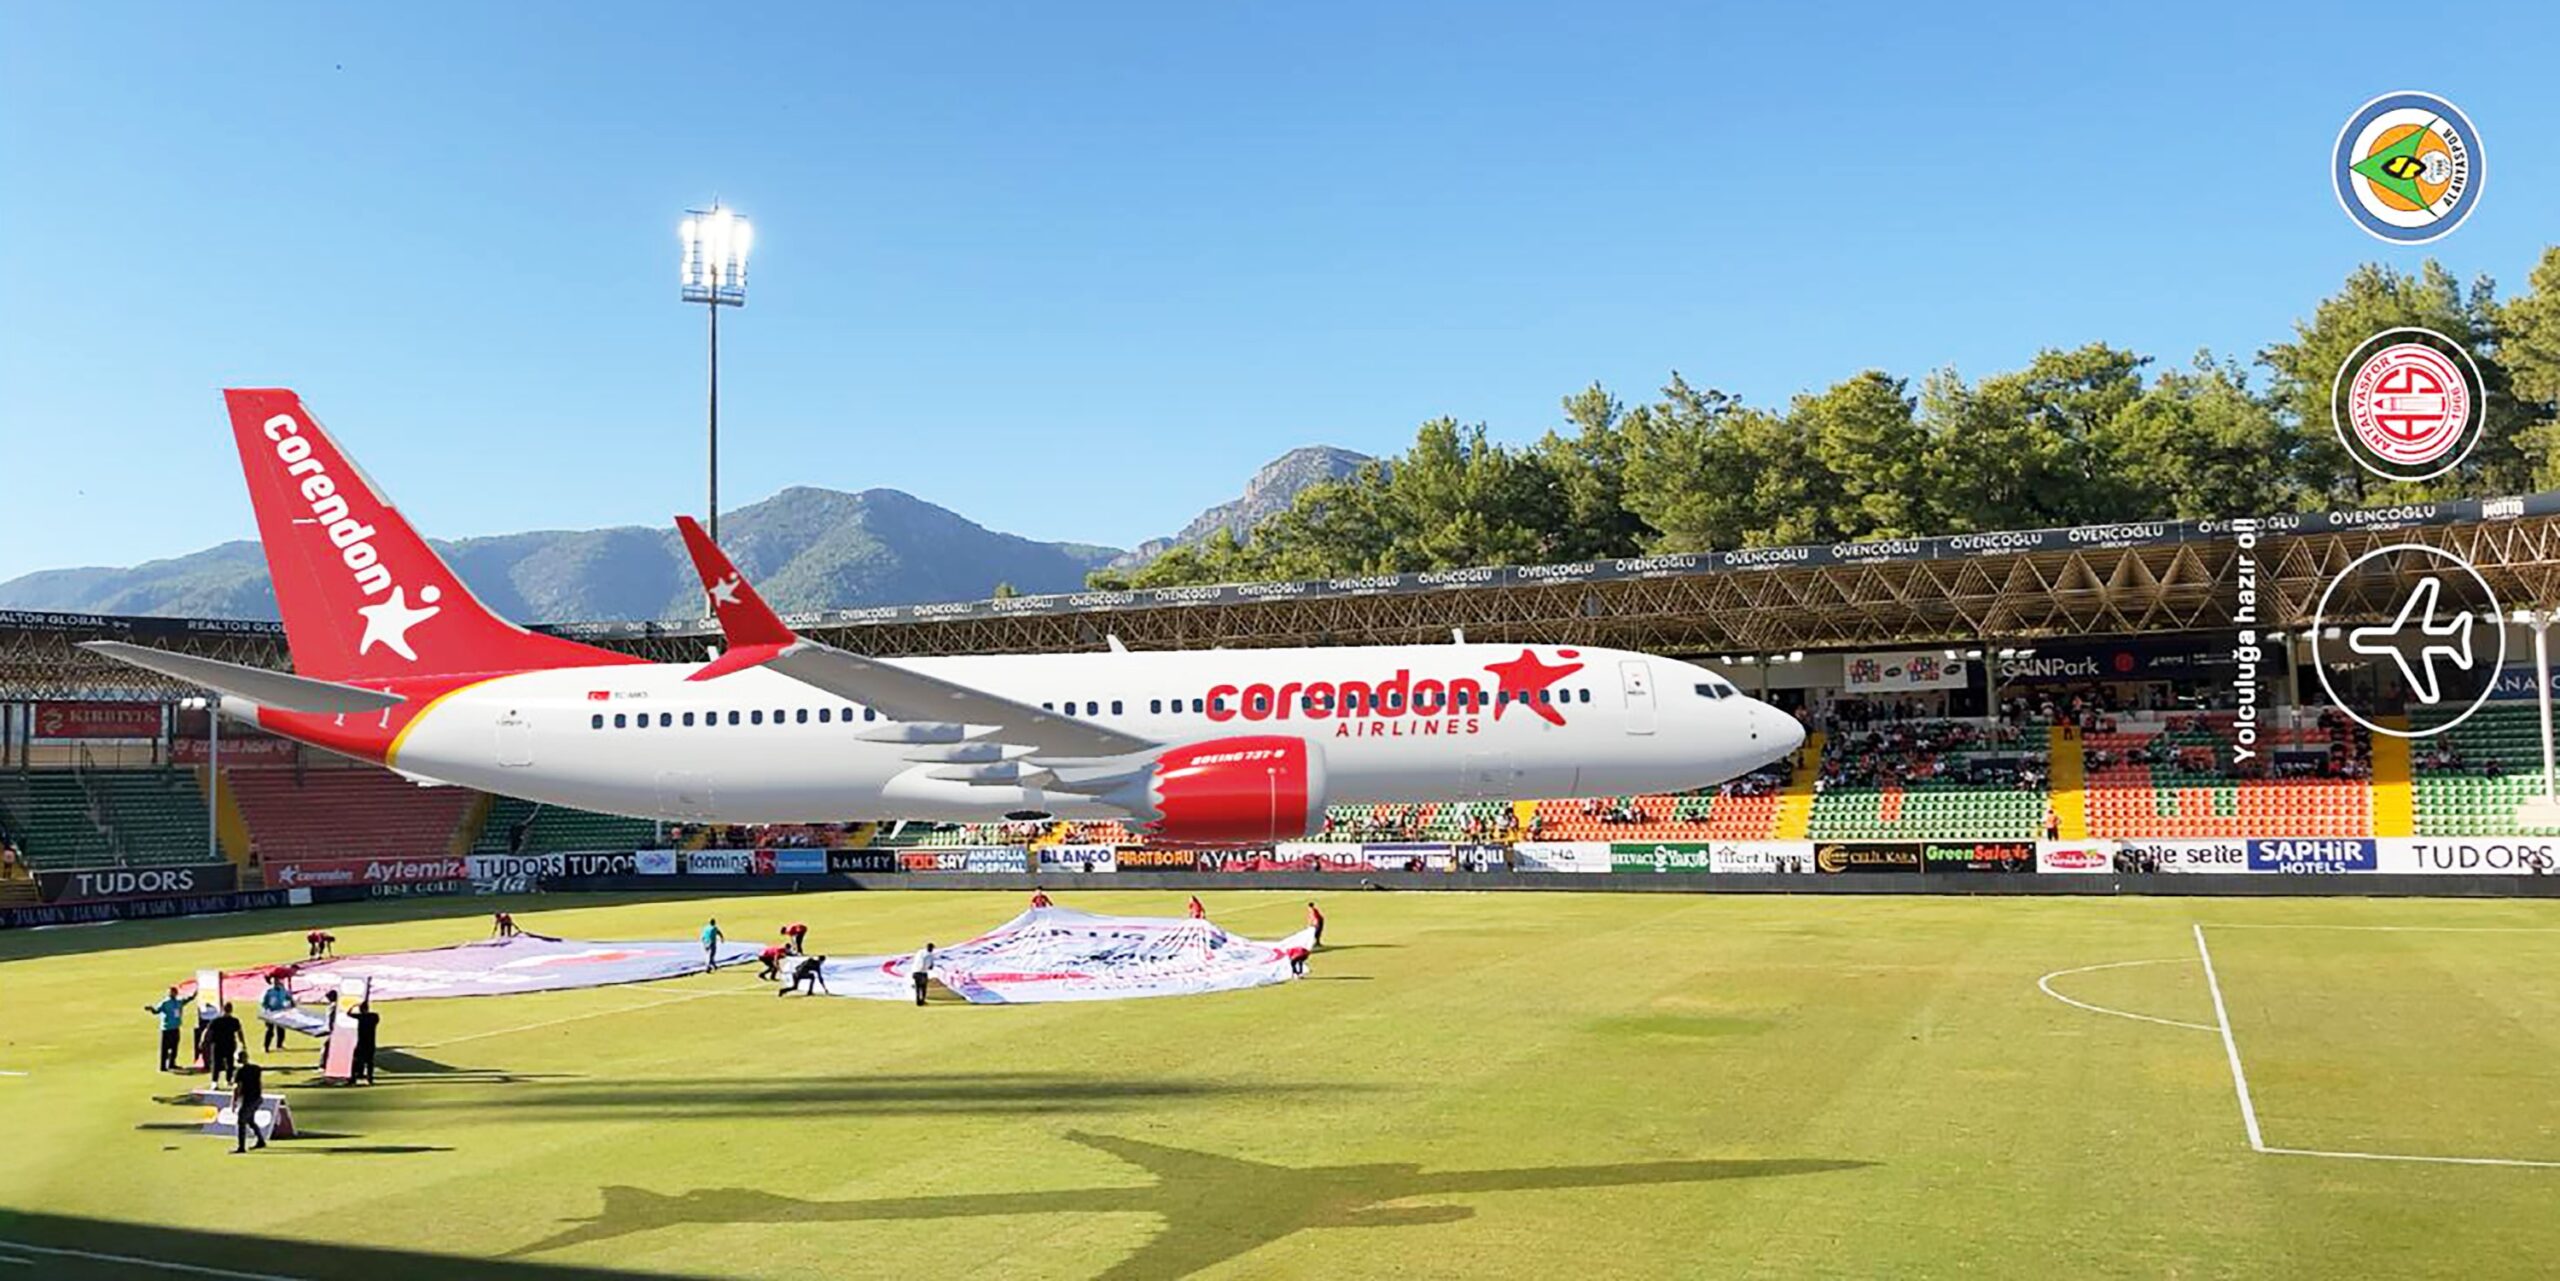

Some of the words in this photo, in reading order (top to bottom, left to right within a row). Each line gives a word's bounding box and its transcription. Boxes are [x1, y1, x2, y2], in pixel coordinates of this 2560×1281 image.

[263, 413, 392, 596] corendon
[48, 614, 107, 626] GLOBAL
[188, 620, 250, 632] REALTOR
[1205, 669, 1480, 722] corendon
[1336, 718, 1480, 738] AIRLINES
[1191, 751, 1244, 766] BOEING
[832, 856, 890, 869] RAMSEY
[968, 849, 1026, 861] ANATOLIA
[1040, 849, 1112, 864] BLANCO
[1116, 850, 1195, 866] FIRATBORU
[2412, 845, 2554, 869] TUDORS
[364, 858, 460, 882] Aytemiz
[476, 855, 562, 877] TUDORS
[968, 861, 1026, 874] HOSPITAL
[2279, 861, 2346, 874] HOTELS
[77, 869, 194, 896] TUDORS
